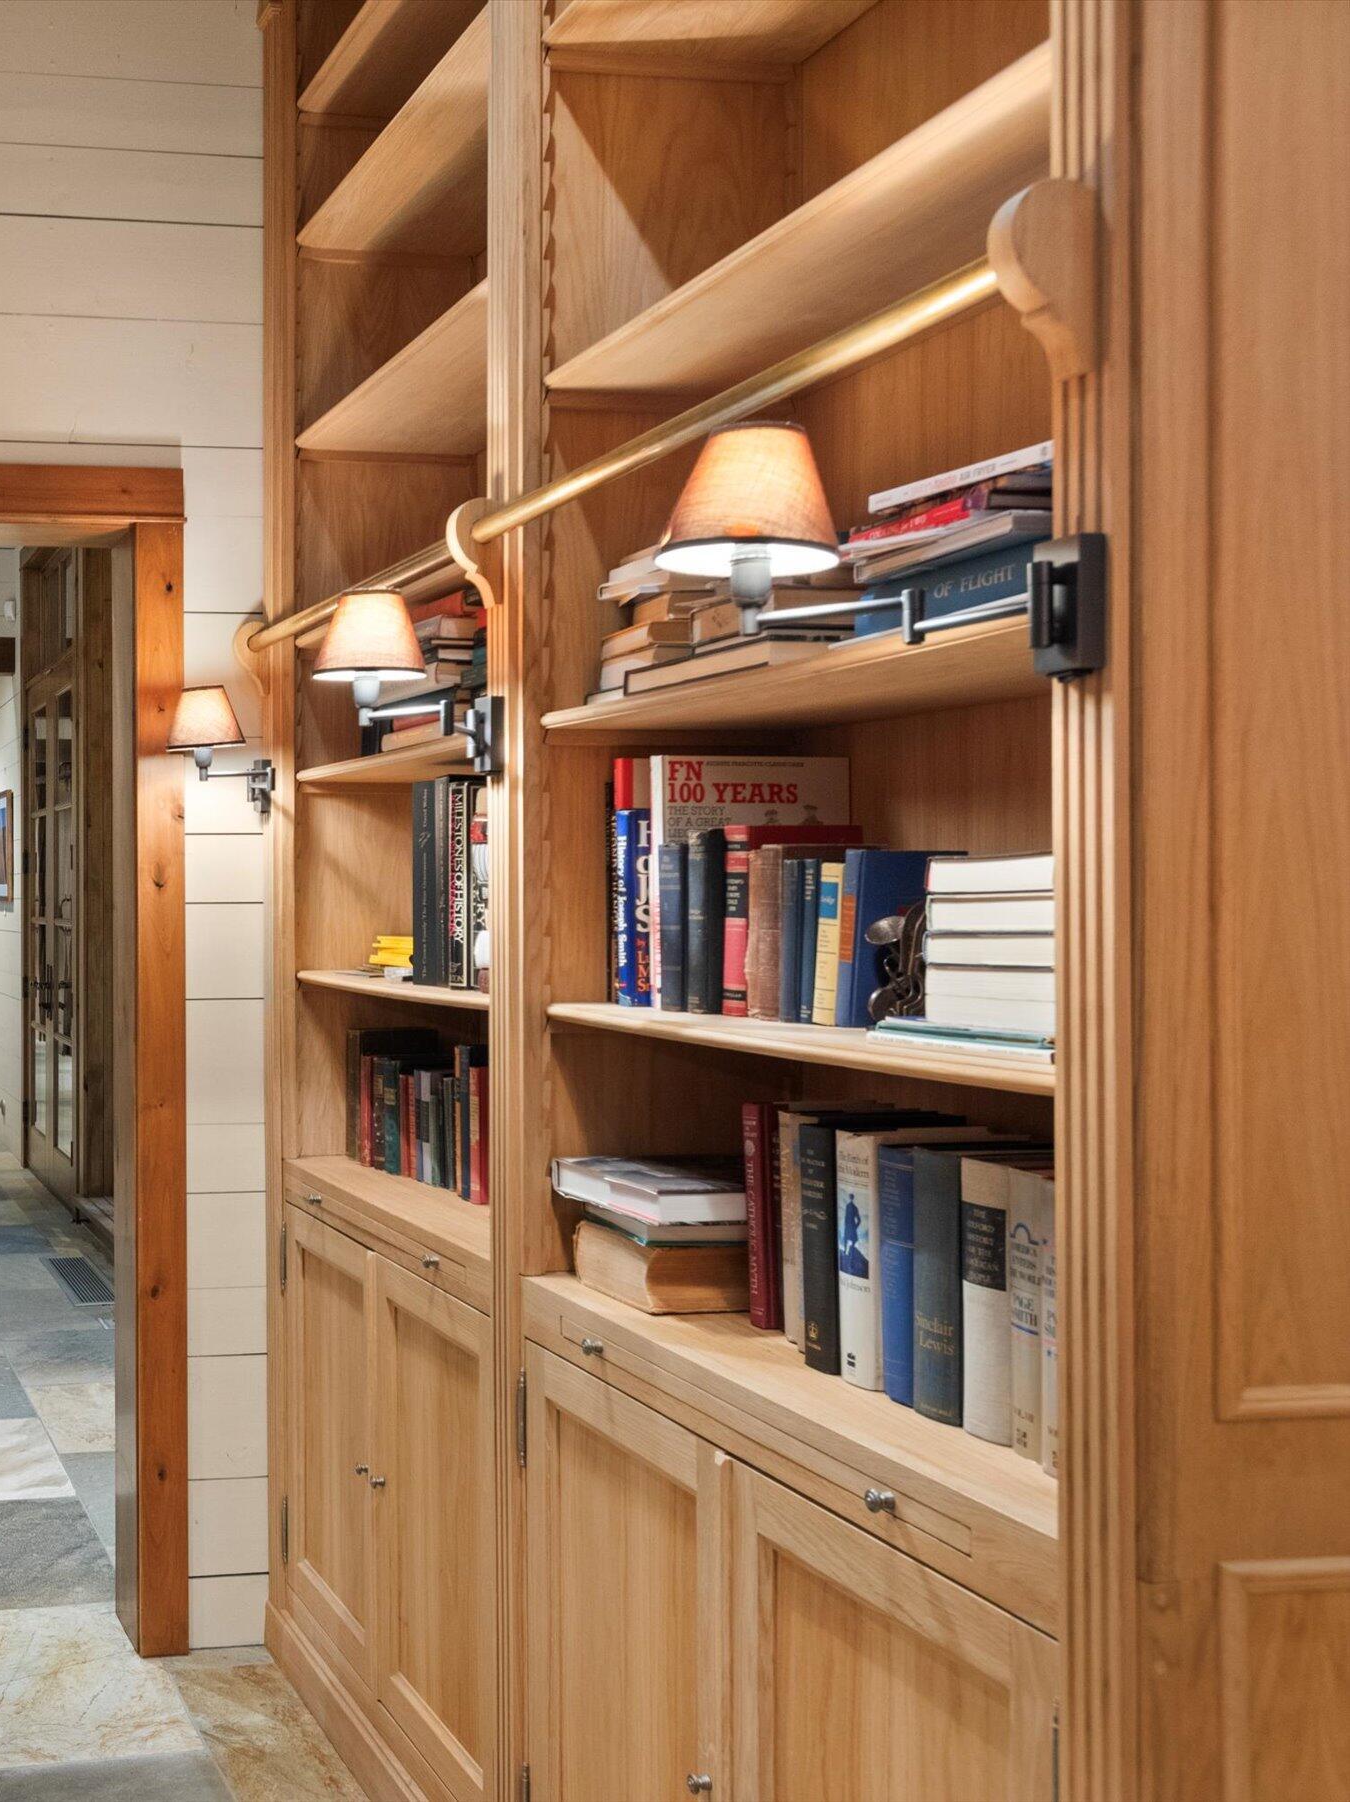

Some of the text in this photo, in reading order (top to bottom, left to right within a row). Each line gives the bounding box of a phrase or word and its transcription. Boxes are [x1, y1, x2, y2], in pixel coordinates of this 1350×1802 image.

[933, 564, 1015, 599] OF FLIGHT
[668, 760, 704, 782] FN
[668, 782, 799, 805] 100 YEARS
[667, 805, 727, 817] THE STORY
[667, 816, 733, 828] OF A GREAT
[454, 793, 464, 944] MILESTONES OF HISTORY
[616, 835, 628, 967] History of Joseph Smith
[748, 1190, 757, 1250] CATHOLIC
[750, 1255, 759, 1295] MYTH
[915, 1311, 954, 1337] Sinclair
[919, 1330, 955, 1356] Lewis
